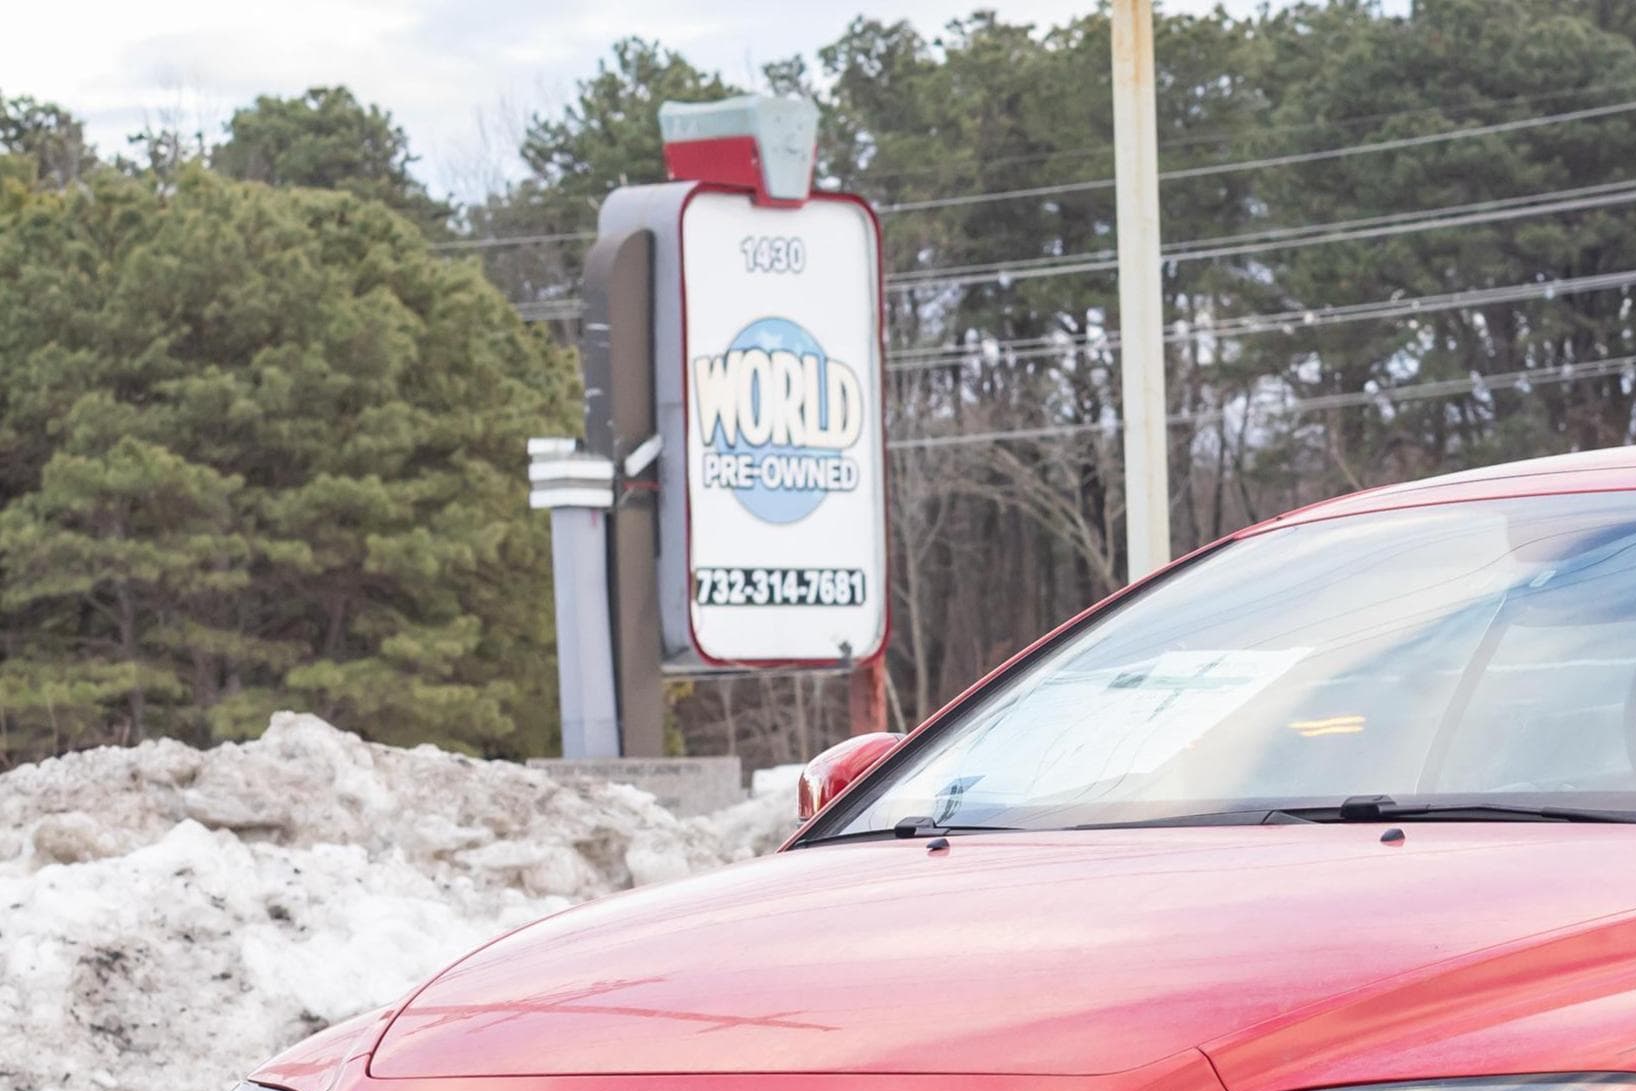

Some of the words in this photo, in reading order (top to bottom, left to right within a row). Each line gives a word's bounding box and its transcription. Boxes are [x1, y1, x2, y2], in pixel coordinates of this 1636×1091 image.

[741, 237, 806, 273] 1430
[694, 347, 863, 450] WORLD
[703, 453, 859, 492] PRE-OWNED
[696, 568, 864, 604] 732-314-7681
